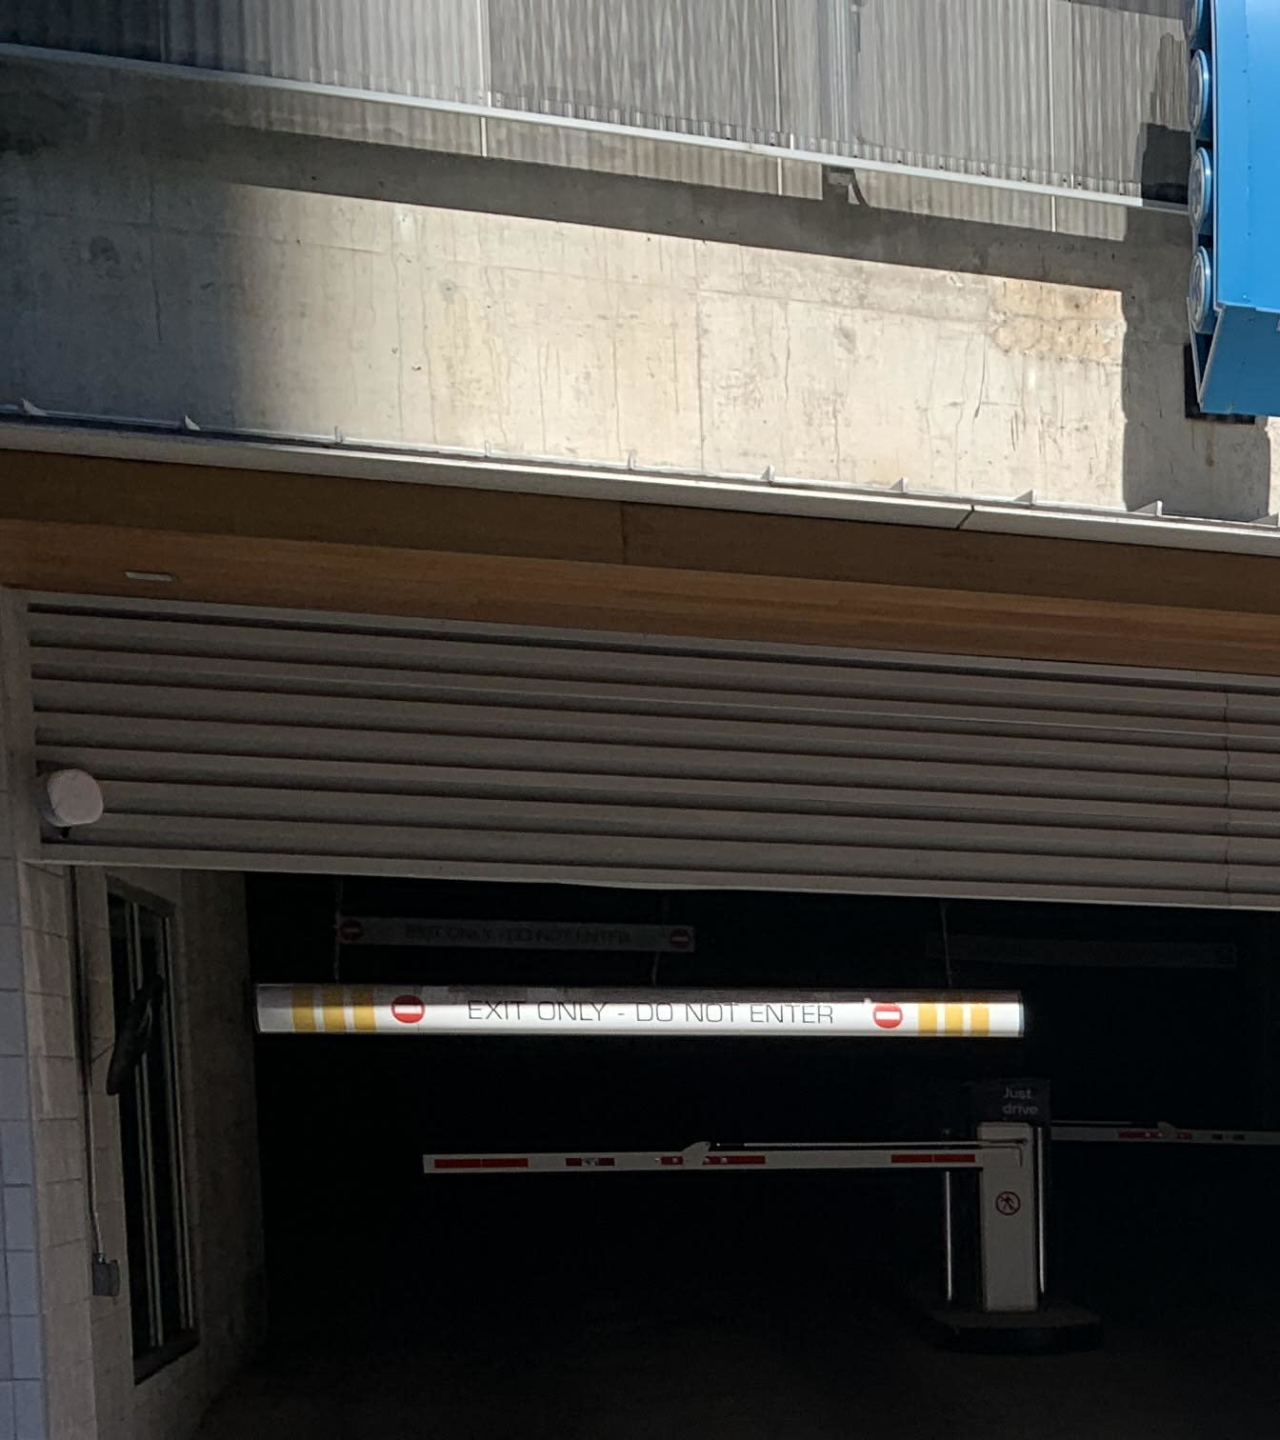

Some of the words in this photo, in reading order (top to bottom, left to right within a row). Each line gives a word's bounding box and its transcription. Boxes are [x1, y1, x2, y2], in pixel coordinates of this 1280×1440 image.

[468, 999, 523, 1020] EXIT
[537, 1000, 607, 1021] ONLY
[637, 1002, 673, 1022] DO
[685, 1002, 739, 1023] NOT
[750, 1003, 834, 1024] ENTER
[1003, 1087, 1032, 1099] Just
[1002, 1102, 1039, 1115] drive
